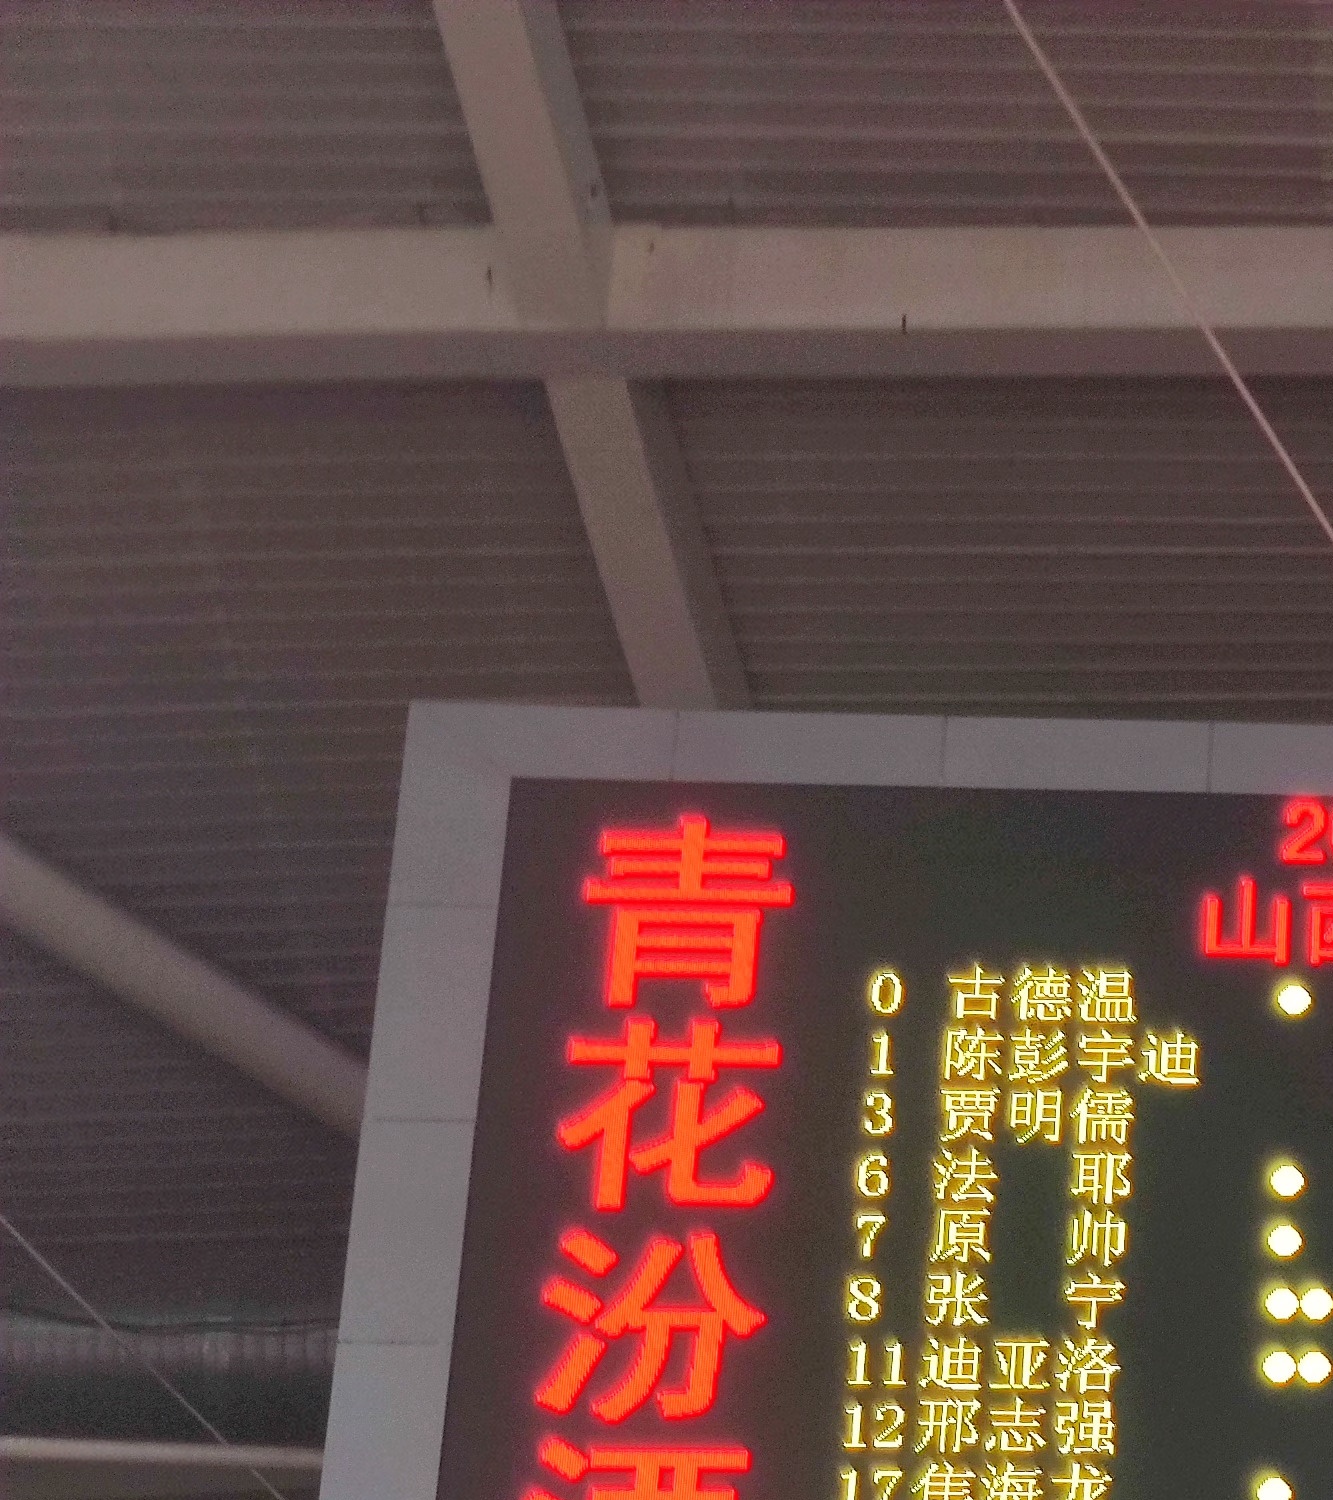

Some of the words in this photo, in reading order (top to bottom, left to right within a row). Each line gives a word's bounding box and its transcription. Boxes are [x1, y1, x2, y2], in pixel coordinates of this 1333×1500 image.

[870, 969, 904, 1015] 0
[947, 963, 1138, 1024] 古德温
[869, 1031, 895, 1076] 1
[942, 1024, 1201, 1086] 陈彭宇迪
[863, 1090, 894, 1136] 3
[939, 1086, 1136, 1146] 贾明儒
[856, 1152, 890, 1198] 6
[856, 1212, 887, 1259] 7
[846, 1277, 882, 1322] 8
[846, 1340, 908, 1387] 11
[916, 1334, 1123, 1396] 迪亚洛
[842, 1402, 906, 1449] 12
[912, 1395, 1117, 1456] 邢志强
